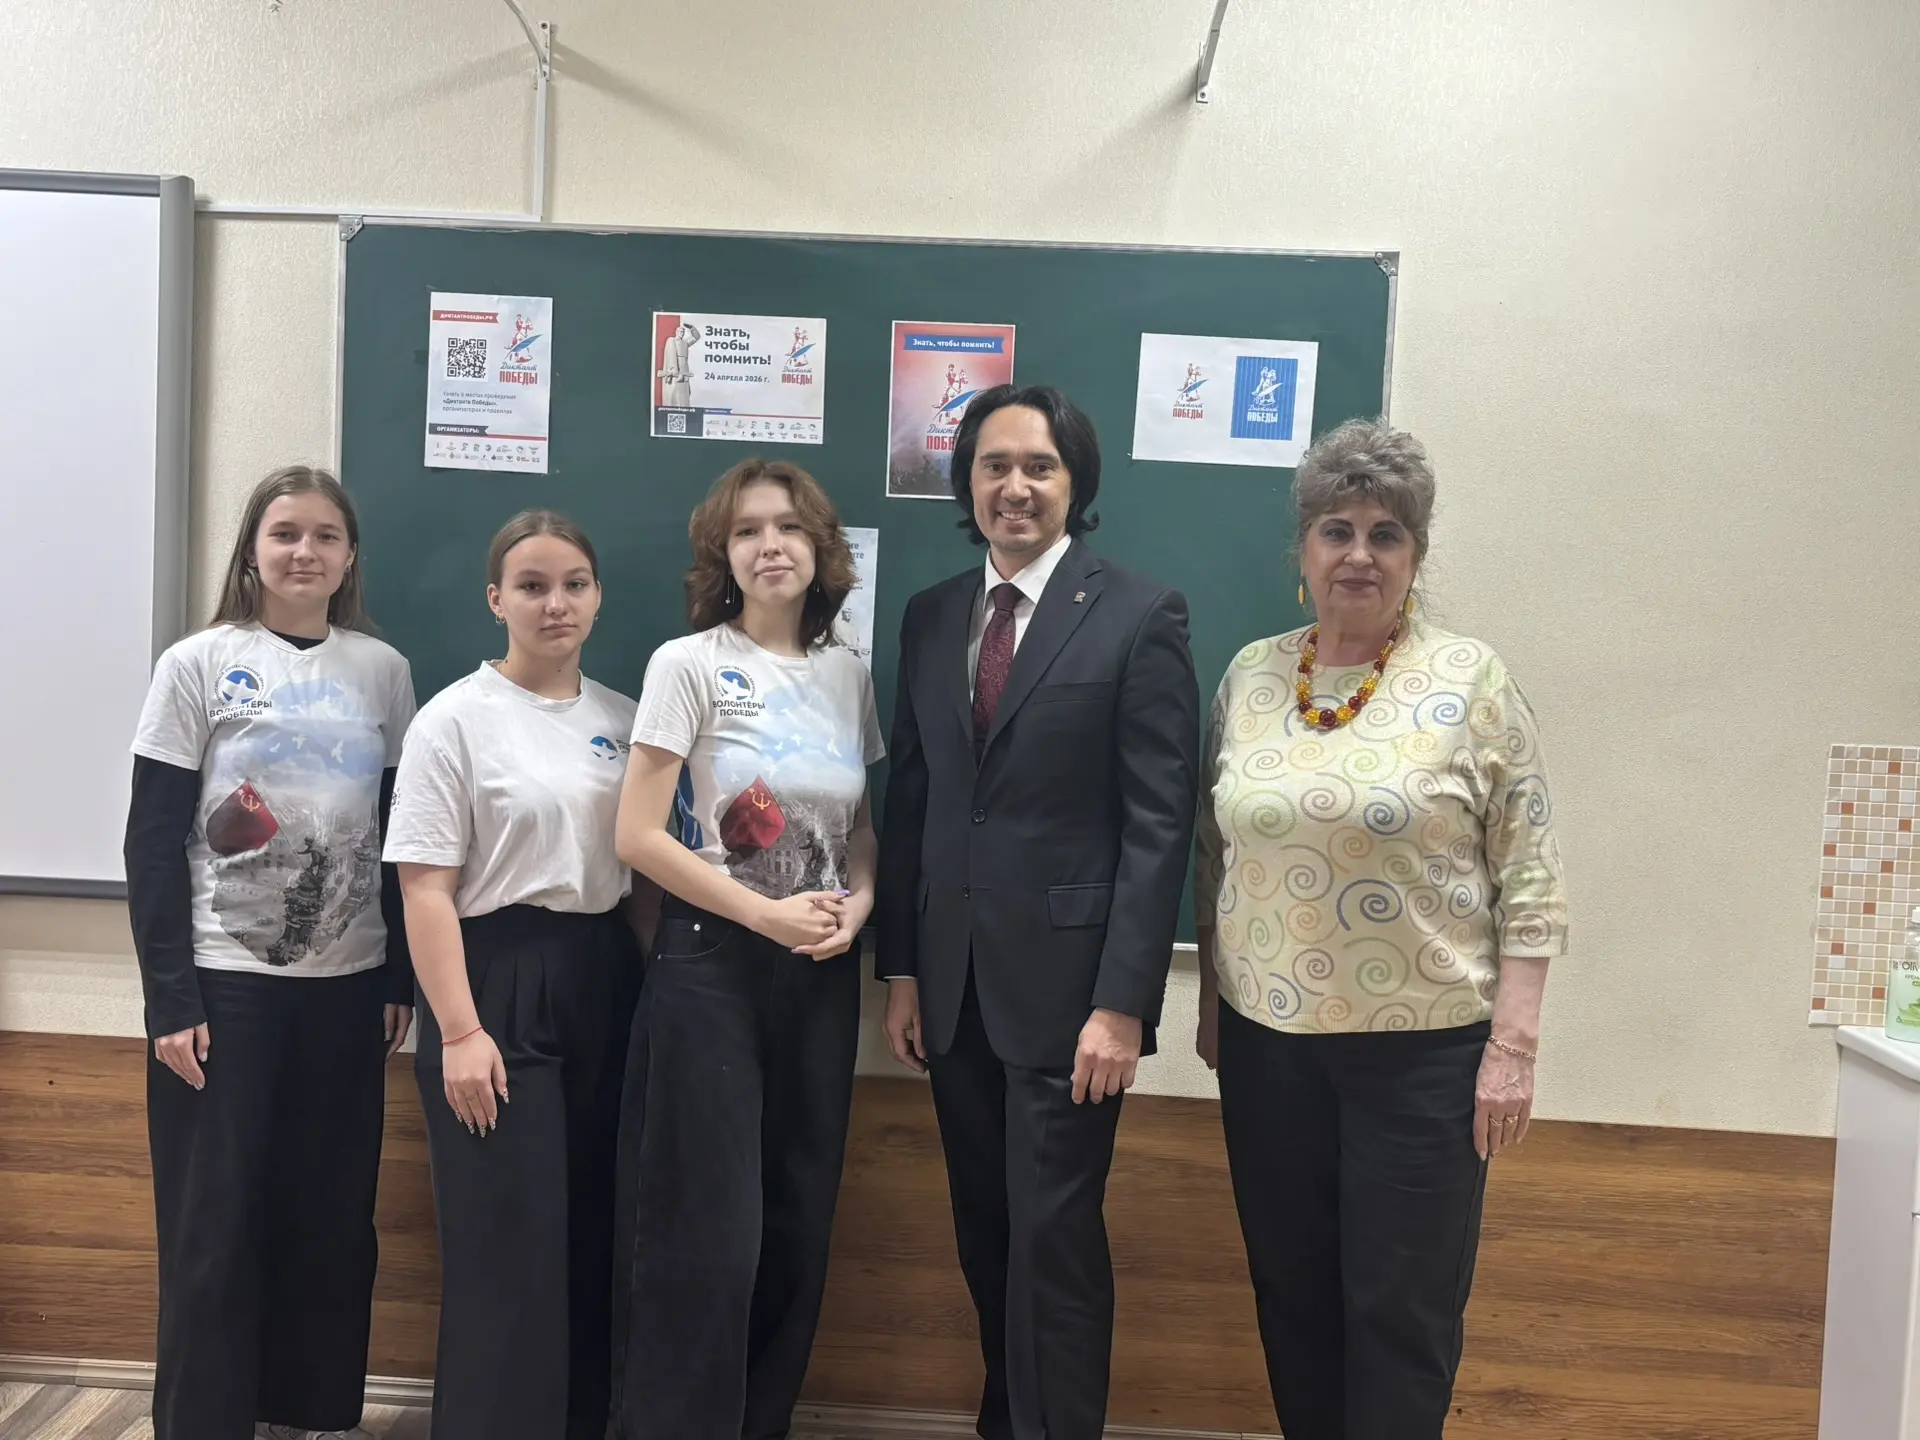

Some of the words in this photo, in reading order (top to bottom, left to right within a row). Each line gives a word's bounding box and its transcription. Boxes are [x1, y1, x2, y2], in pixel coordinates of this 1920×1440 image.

[705, 325, 750, 340] Знать,
[704, 340, 750, 352] чтобы
[912, 338, 936, 348] Знать,
[937, 340, 960, 349] чтобы
[961, 340, 995, 349] помнить!
[704, 353, 772, 366] помнить!
[500, 362, 538, 372] Диктант
[499, 371, 538, 386] ПОБЕДЫ
[704, 372, 716, 381] 24
[716, 374, 744, 382] АПРЕЛЯ
[744, 375, 763, 383] 2026
[781, 373, 813, 386] ПОБЕДЫ
[1172, 408, 1203, 420] ПОБЕДЫ
[1247, 412, 1278, 424] ПОБЕДЫ
[436, 426, 480, 434] ОРГАНИЗАТОРЫ:
[926, 435, 955, 450] ПОБЕ
[720, 708, 759, 717] ПОБЕДЫ
